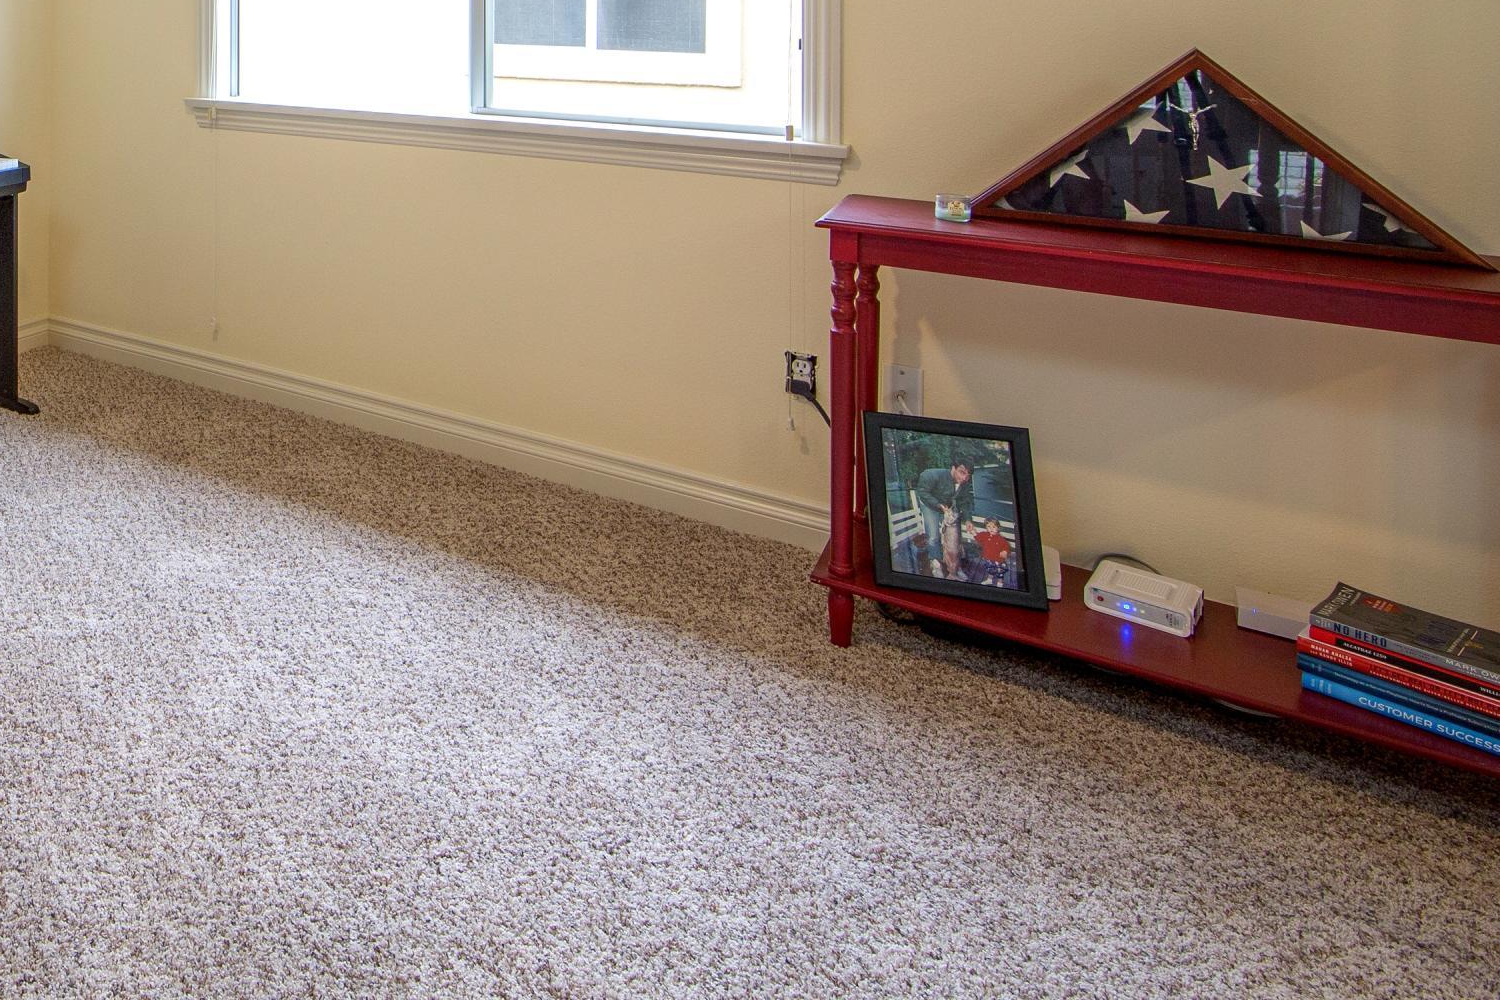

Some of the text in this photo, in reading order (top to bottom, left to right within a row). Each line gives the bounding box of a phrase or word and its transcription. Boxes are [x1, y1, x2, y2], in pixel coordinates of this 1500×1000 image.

[1334, 623, 1350, 636] NO
[1355, 629, 1387, 648] HERO
[1343, 642, 1372, 655] ALCATRAZ
[1446, 659, 1478, 674] MARK
[1359, 696, 1432, 728] CUSTOMER
[1436, 724, 1500, 753] SUCCESS
